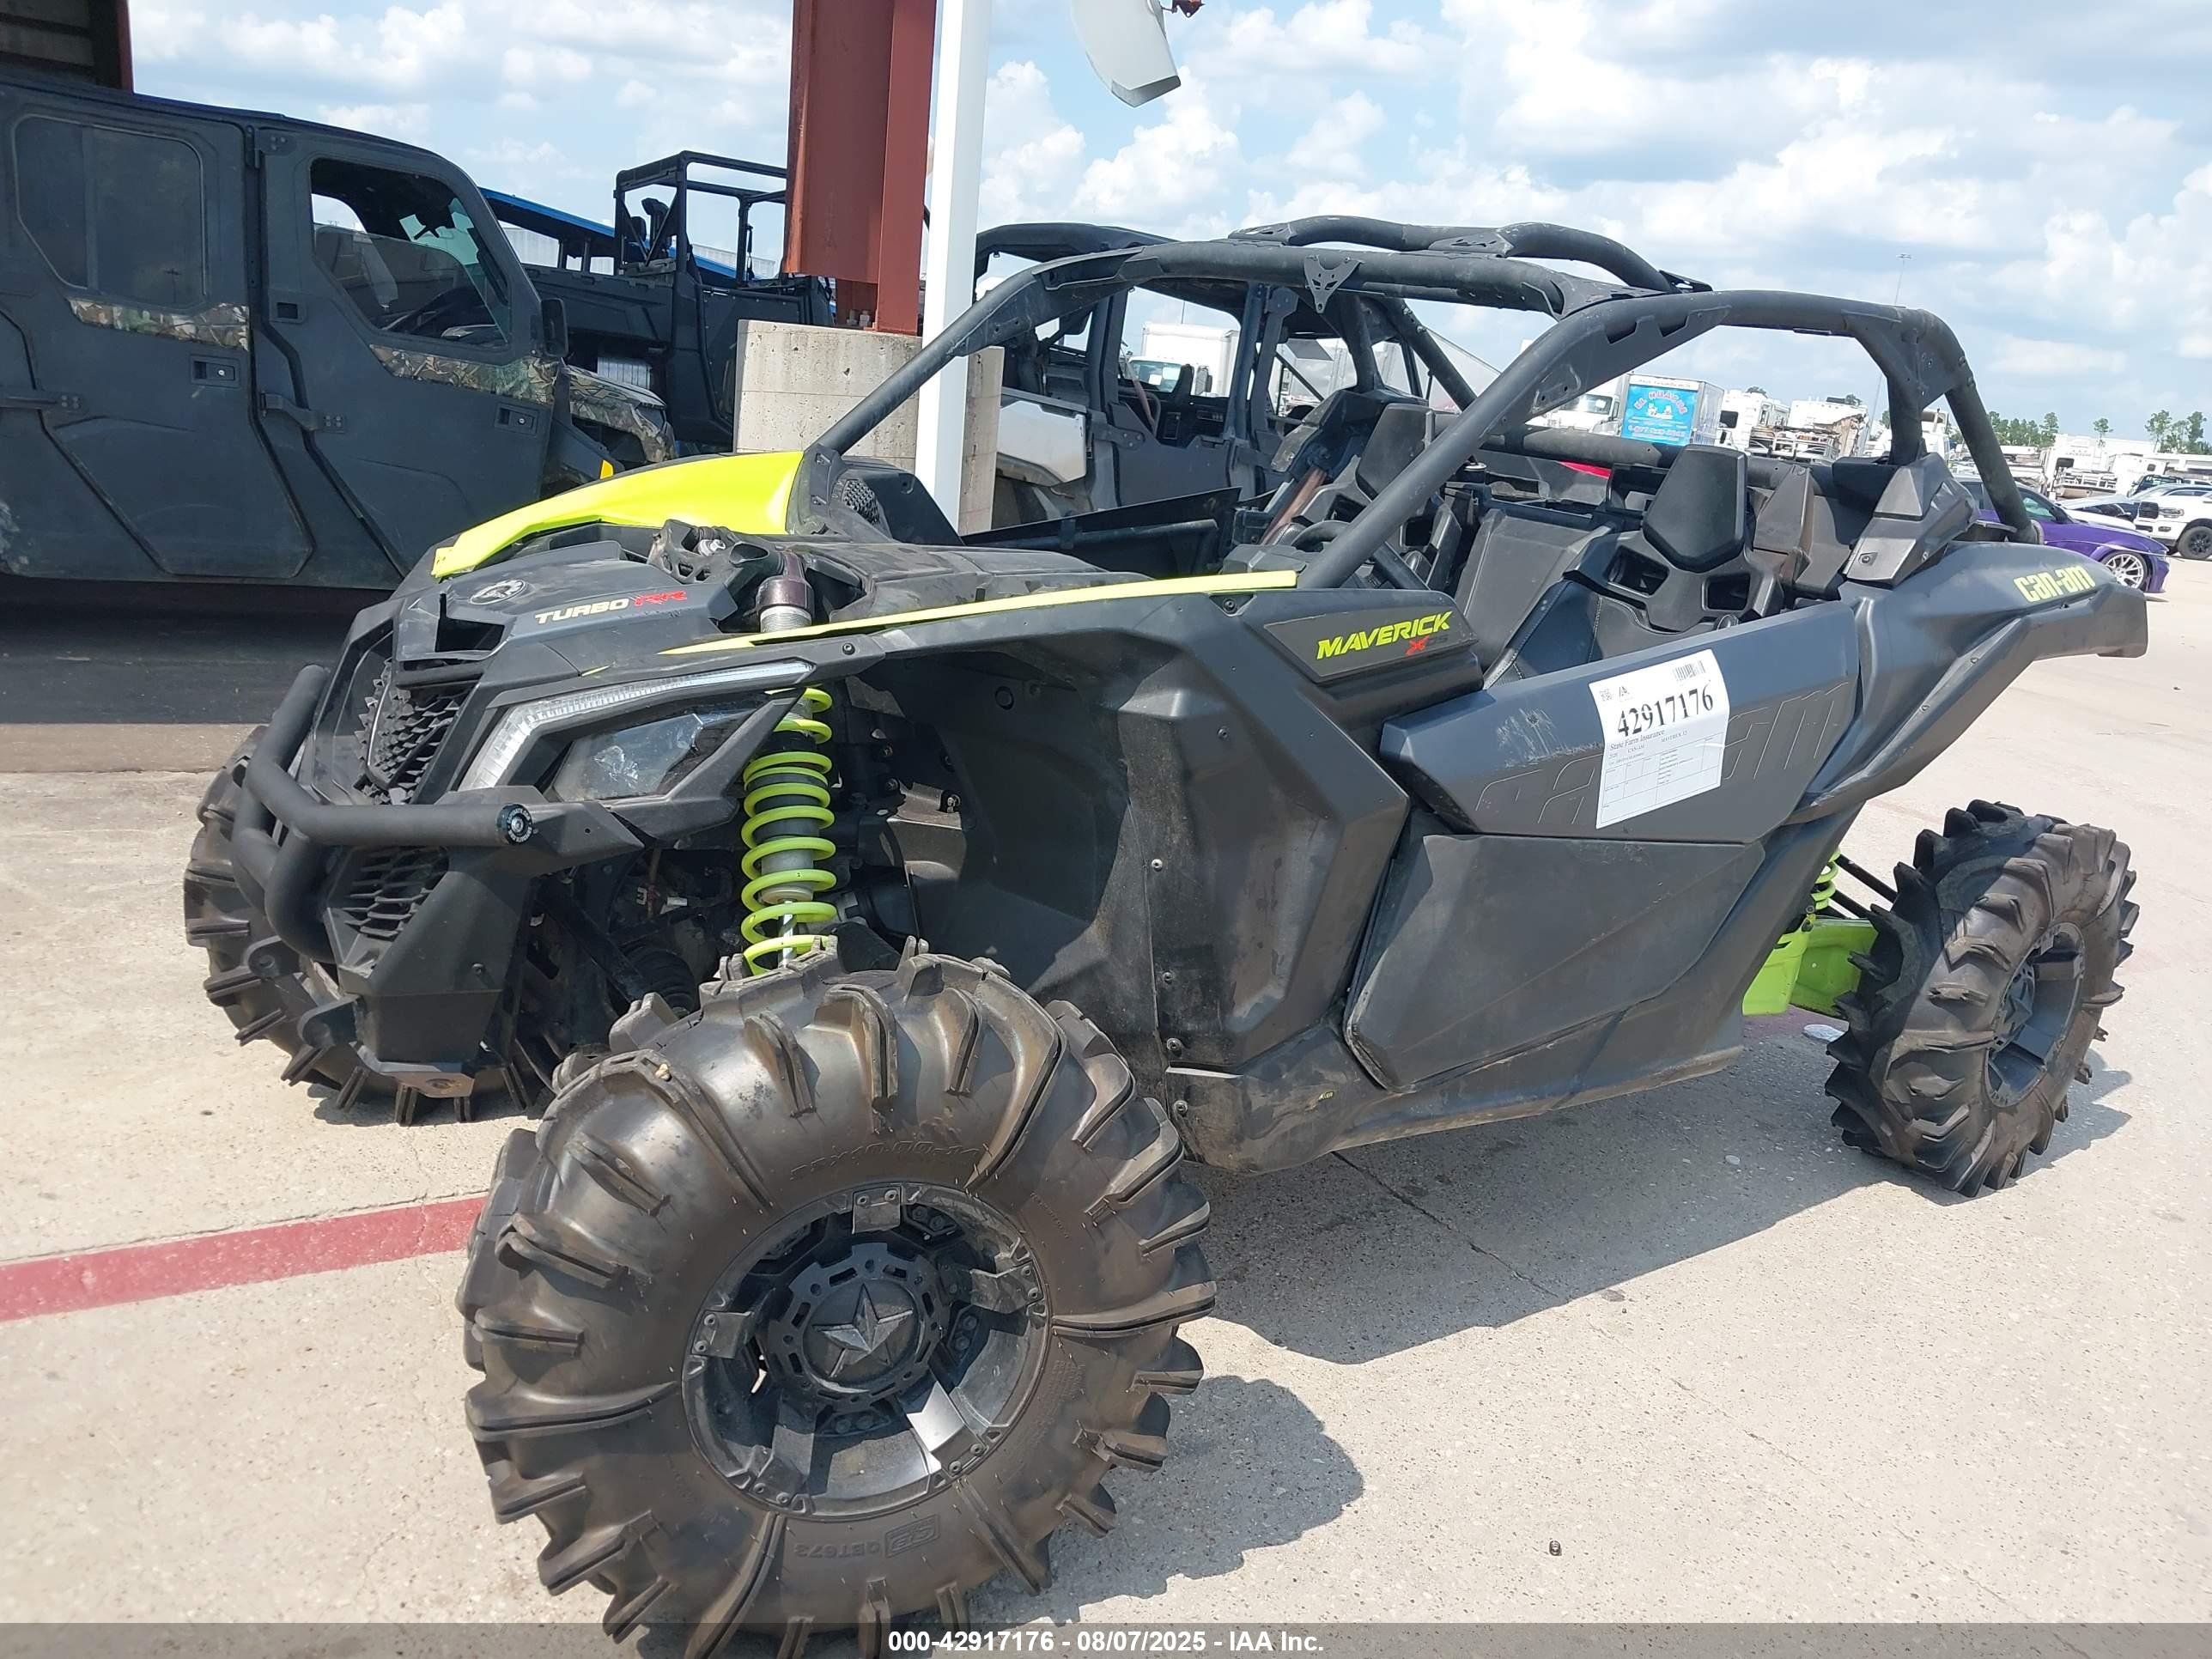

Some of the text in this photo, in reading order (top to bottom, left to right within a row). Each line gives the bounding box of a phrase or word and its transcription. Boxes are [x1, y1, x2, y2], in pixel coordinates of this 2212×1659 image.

[2013, 565, 2096, 603] can-am
[534, 598, 629, 624] TURBO
[1316, 611, 1453, 659] MAVERICK
[1617, 679, 1714, 738] 42917176
[1610, 730, 1664, 750] State Farm Insurance
